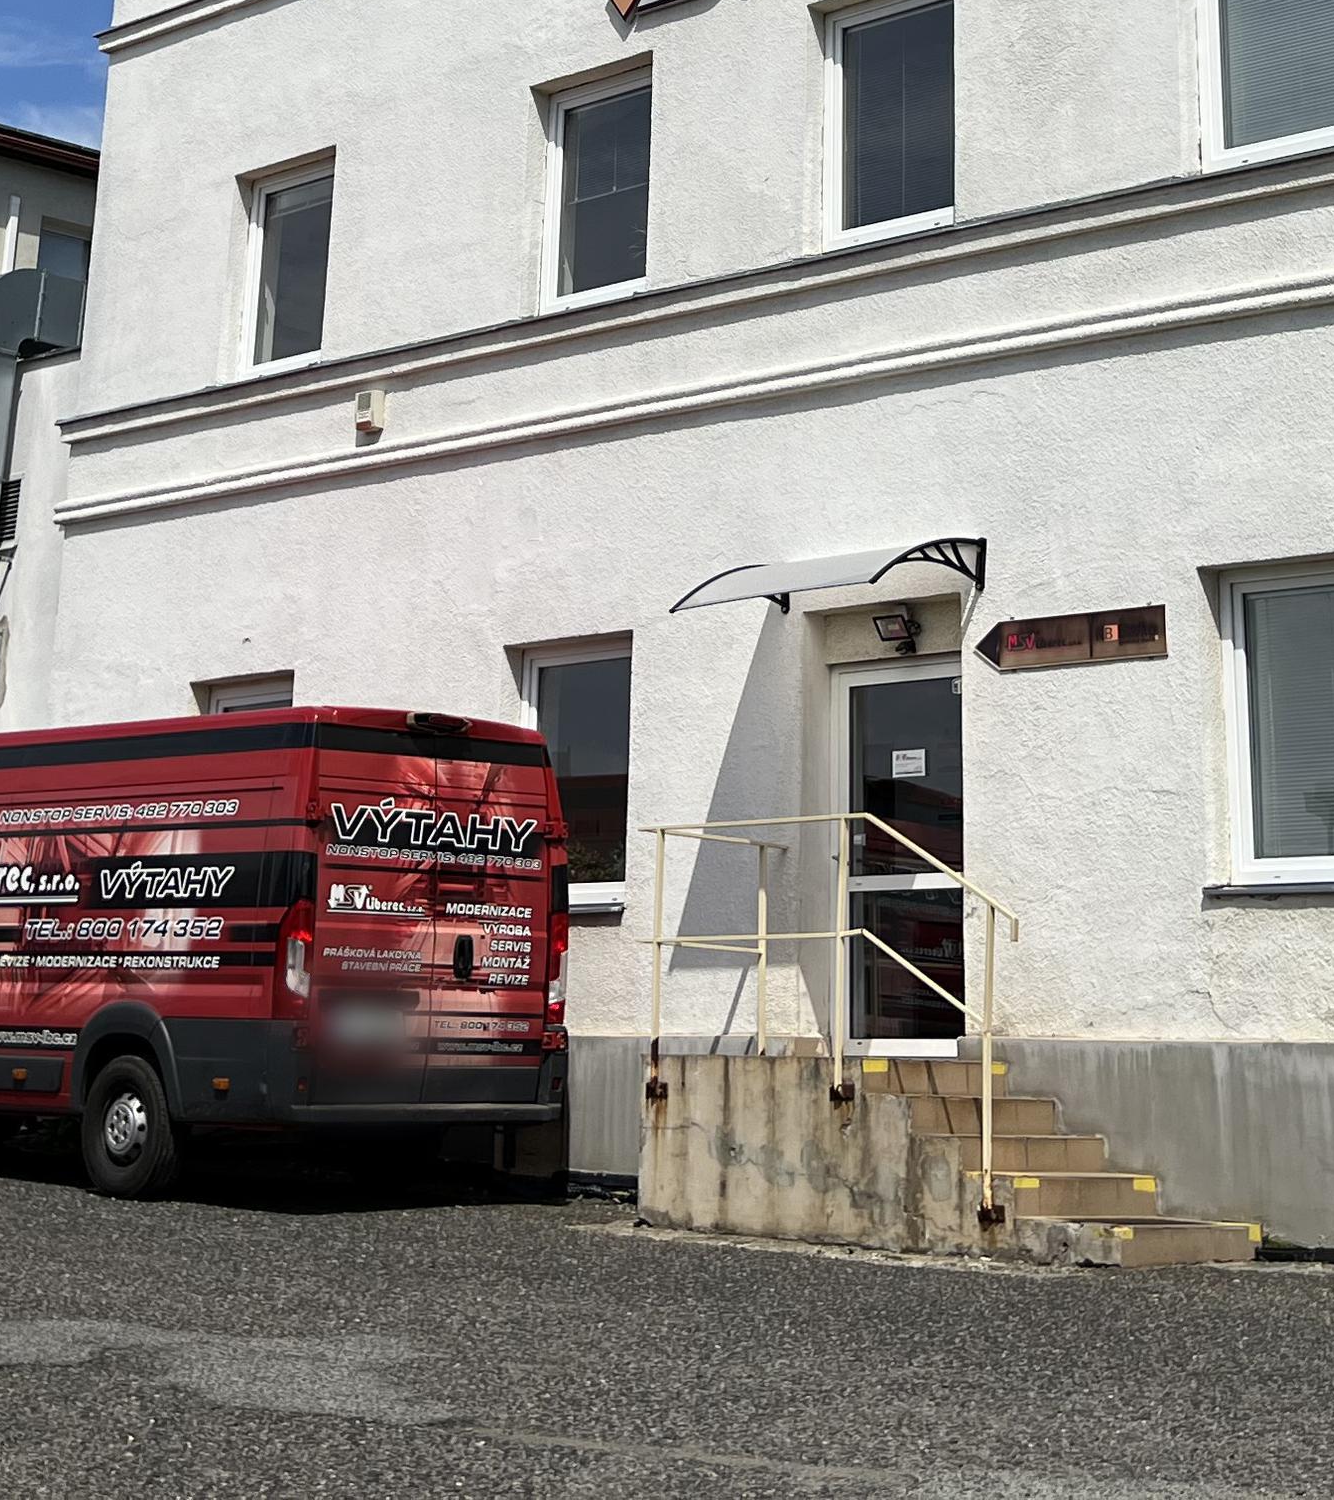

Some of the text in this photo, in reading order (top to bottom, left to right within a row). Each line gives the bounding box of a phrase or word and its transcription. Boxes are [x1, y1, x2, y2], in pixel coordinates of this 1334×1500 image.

[73, 804, 134, 821] SERVIS:
[135, 802, 168, 819] 482
[169, 801, 203, 817] 770
[203, 799, 240, 816] 303
[331, 797, 538, 852] VÝTAHY
[326, 843, 543, 871] NONSTOP SERVIS: 482 770 303
[38, 873, 80, 892] s.r.o.
[100, 860, 235, 900] VÝTAHY
[328, 884, 370, 909] MSV
[445, 902, 533, 919] MODERNIZACE
[25, 916, 224, 941] TEL.: 800 174 352
[483, 921, 532, 937] VÝROBA
[377, 948, 422, 960] LAKOVNA
[489, 939, 533, 953] SERVIS
[35, 955, 117, 968] MODERNIZACE
[123, 955, 220, 969] REKONSTRUKCE
[481, 954, 532, 970] MONTÁŽ
[487, 973, 530, 987] REVIZE
[460, 1019, 483, 1031] 800
[505, 1021, 530, 1033] 352
